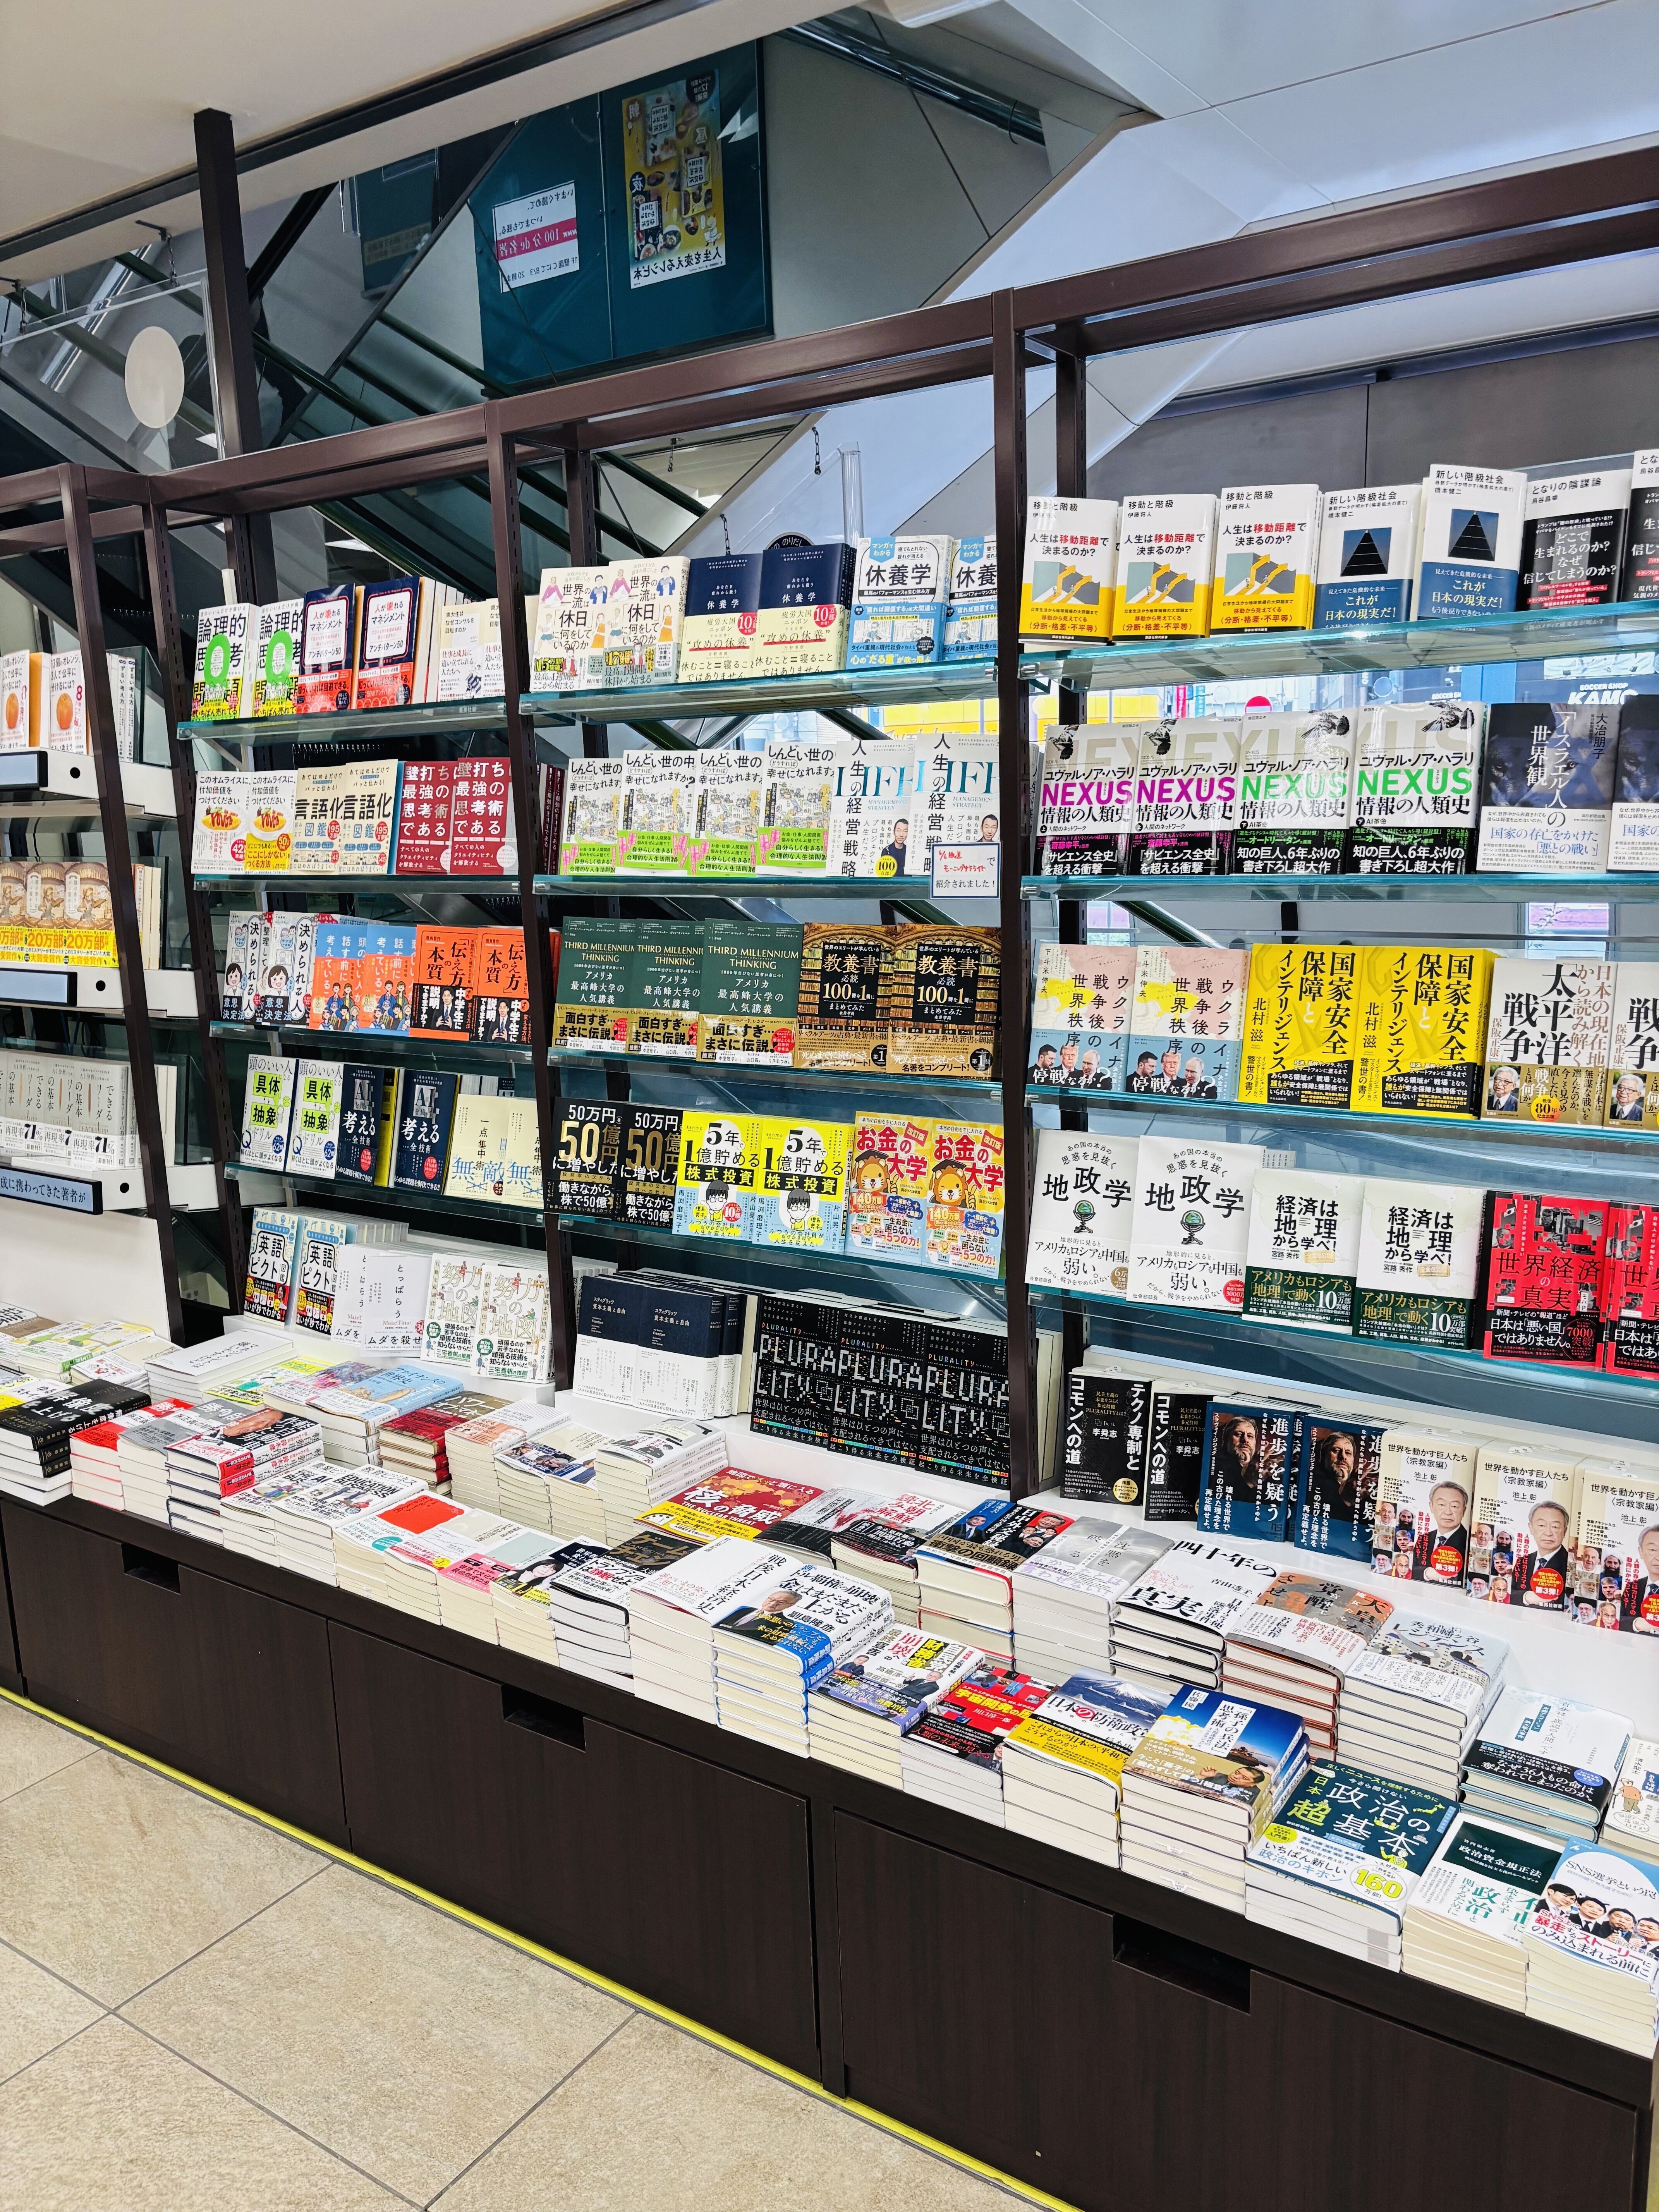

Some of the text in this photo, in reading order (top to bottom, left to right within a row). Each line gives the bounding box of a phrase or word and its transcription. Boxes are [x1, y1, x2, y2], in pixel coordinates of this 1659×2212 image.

[1436, 470, 1504, 484] 新しい階級社会
[1532, 477, 1601, 495] となりの陰謀論
[1226, 491, 1273, 501] 移動と階級
[1223, 522, 1306, 534] 人生は移動距離で
[1556, 531, 1589, 543] どこで
[1235, 535, 1292, 546] 決まるのか?
[1534, 541, 1610, 559] 生まれるのか?
[1558, 555, 1582, 567] なぜ
[630, 575, 658, 590] 世界の
[1523, 565, 1616, 584] 信じてしまうのか?
[1453, 580, 1486, 591] これが
[781, 592, 816, 604] 休養学
[372, 611, 405, 623] マネジメント
[781, 609, 812, 618] 疲労大国
[198, 614, 247, 644] 論理的
[622, 622, 659, 634] に何をして
[1593, 713, 1608, 760] 大治朋子
[626, 752, 695, 768] しんどい世の中
[1139, 763, 1238, 777] ユヴァル・ノア・ハラリ
[199, 775, 251, 785] このオムライスに、
[199, 786, 232, 795] 付加価値を
[456, 780, 503, 797] 最強の
[1137, 776, 1235, 804] NEXUS
[199, 797, 240, 805] つけてください
[343, 792, 391, 821] 言語化
[455, 799, 503, 816] 思考術
[842, 740, 867, 878] 人生の経営戦略
[1136, 804, 1233, 821] 情報の人類史
[455, 819, 501, 835] である
[1491, 827, 1598, 840] 国家の存亡をかけた
[987, 857, 995, 866] で
[1353, 844, 1464, 860] 知の巨人、6年ぶりの
[878, 861, 895, 871] 100
[1359, 860, 1455, 874] 書き下ろし超大作
[708, 945, 799, 959] THIRD MILLENNIUM
[485, 948, 503, 984] 本質
[730, 958, 776, 970] THINKING
[916, 955, 979, 977] 教養書
[735, 979, 769, 988] アメリカ
[265, 998, 282, 1008] 意思
[718, 989, 783, 1003] 最高峰大学の
[486, 998, 497, 1022] 説明
[728, 1002, 772, 1015] 人気講義
[924, 1007, 962, 1016] まとめてみた
[1166, 978, 1191, 1054] 世界秩序
[1190, 977, 1213, 1055] 戦争後の
[1382, 952, 1412, 1073] インテリジェンス
[1439, 953, 1474, 1061] 国家安全
[1587, 965, 1612, 1067] 日本の現在地
[509, 999, 521, 1043] 中学生に
[1212, 979, 1234, 1077] ウクライナ
[1489, 1018, 1503, 1058] 保阪正康
[306, 1080, 332, 1100] 具体
[304, 1112, 329, 1131] 抽象
[568, 1104, 616, 1123] 50万円
[401, 1117, 439, 1144] 考える
[856, 1125, 912, 1154] お金の
[886, 1154, 928, 1182] 大学
[1166, 1160, 1229, 1178] 思惑を見抜く
[558, 1183, 611, 1196] 働きながら
[766, 1174, 836, 1193] 株式投資
[1145, 1174, 1245, 1218] 地政学
[1388, 1206, 1454, 1230] 経済は
[259, 1235, 283, 1257] 英語
[250, 1257, 279, 1278] ピクト
[1137, 1255, 1243, 1276] アメリカもロシアも中国も
[1495, 1252, 1602, 1281] 世界経済
[394, 1264, 404, 1319] とっぱらう
[1066, 1377, 1085, 1466] コモンへの道
[1127, 1382, 1146, 1470] テクノ専制と
[920, 1444, 1009, 1470] 支配されるべきではない
[1485, 1462, 1568, 1481] 世界を動かす巨人たち
[334, 1477, 391, 1498] BUSINESS
[343, 1474, 404, 1495] EDUCATION
[684, 1486, 782, 1524] 核の脅威
[697, 1506, 726, 1519] NUCLEAR
[728, 1515, 756, 1525] THREAT
[1204, 1488, 1213, 1530] 再定義せよ。
[1172, 1540, 1277, 1578] 四十年の
[695, 1554, 788, 1615] 戦後日本経済史
[1127, 1585, 1204, 1618] 真実
[787, 1610, 836, 1632] 副島隆彦
[907, 1639, 944, 1668] 財務省
[1326, 1762, 1439, 1802] 正しくニュースを理解するために
[1286, 1798, 1332, 1826] 超
[1326, 1783, 1431, 1832] 政治の
[1333, 1812, 1421, 1856] 基本
[1257, 1848, 1343, 1882] 政治のキホン
[1458, 1845, 1543, 1878] 政治資金規正法
[1350, 1869, 1403, 1899] 160
[1532, 1924, 1650, 1977] のみ込まれる前に
